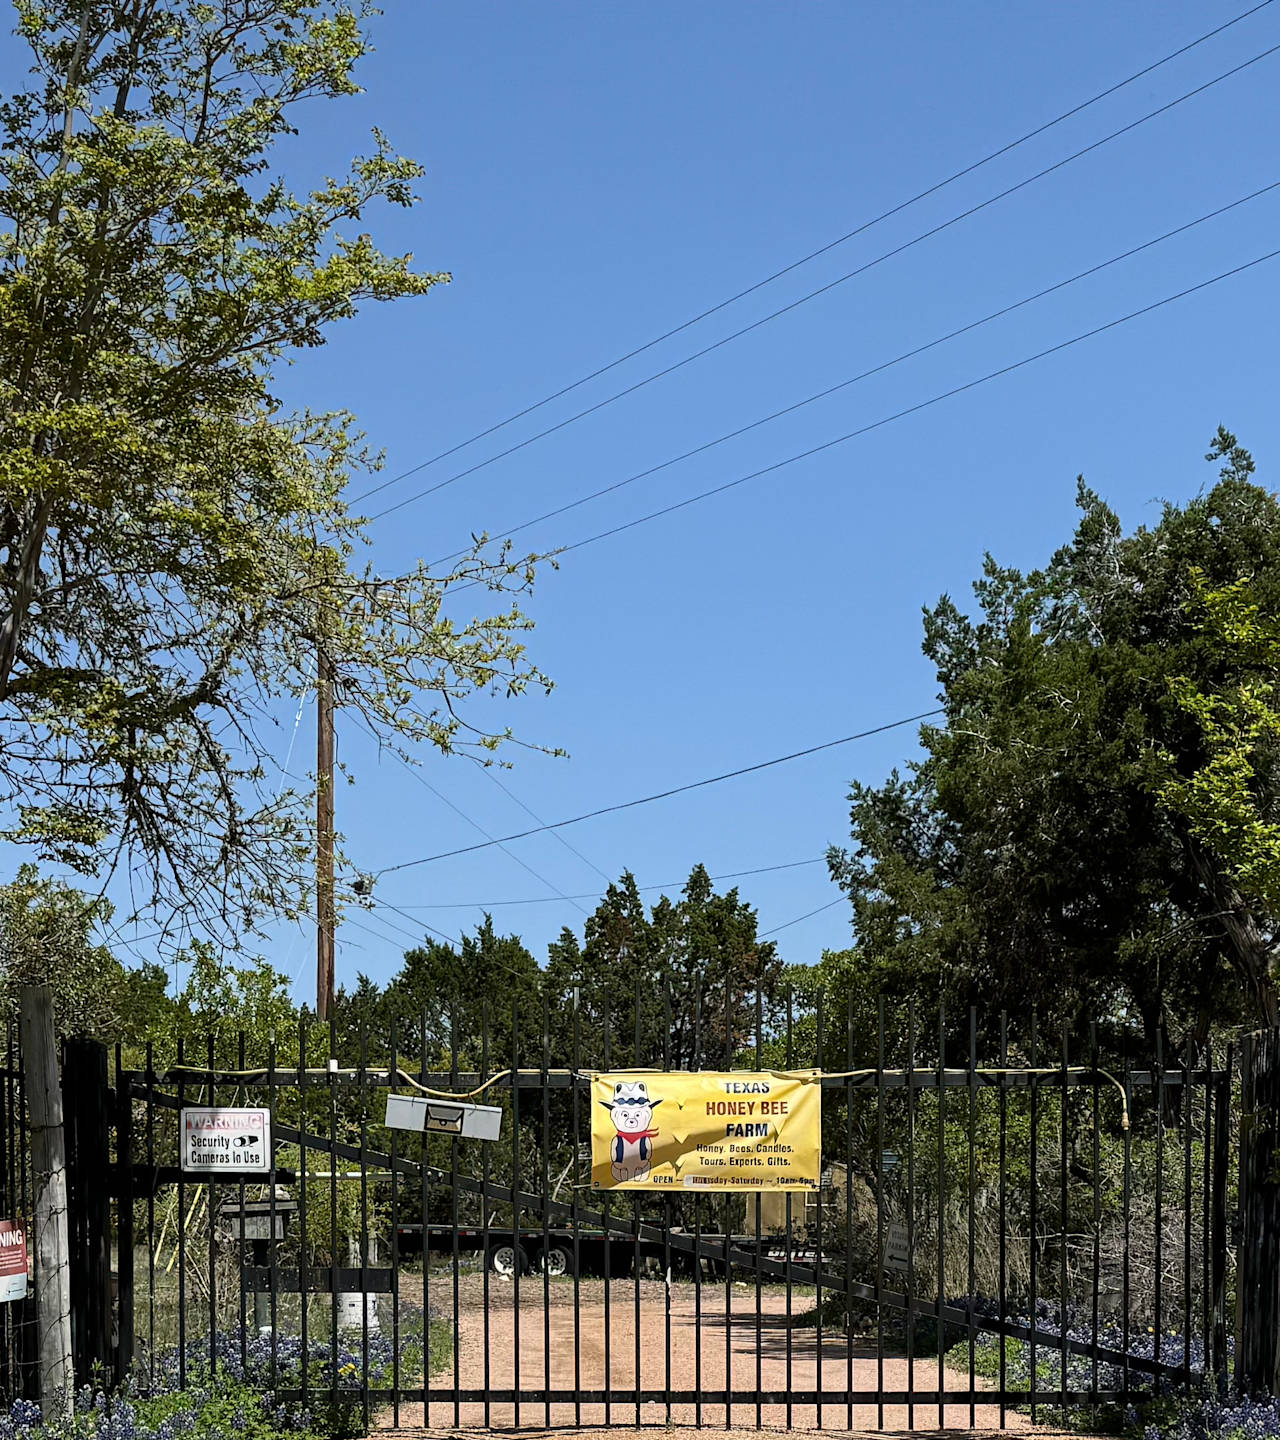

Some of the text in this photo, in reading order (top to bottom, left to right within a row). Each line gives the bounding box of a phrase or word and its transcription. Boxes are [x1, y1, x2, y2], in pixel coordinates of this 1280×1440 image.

[725, 1082, 770, 1094] TEXAS
[705, 1101, 788, 1116] HONEY BEE
[190, 1115, 262, 1129] WARNING
[726, 1123, 768, 1138] FARM
[191, 1134, 230, 1150] Security
[191, 1150, 260, 1164] Cameras In Use
[767, 1156, 791, 1167] Gifts.
[653, 1175, 674, 1184] OPEN
